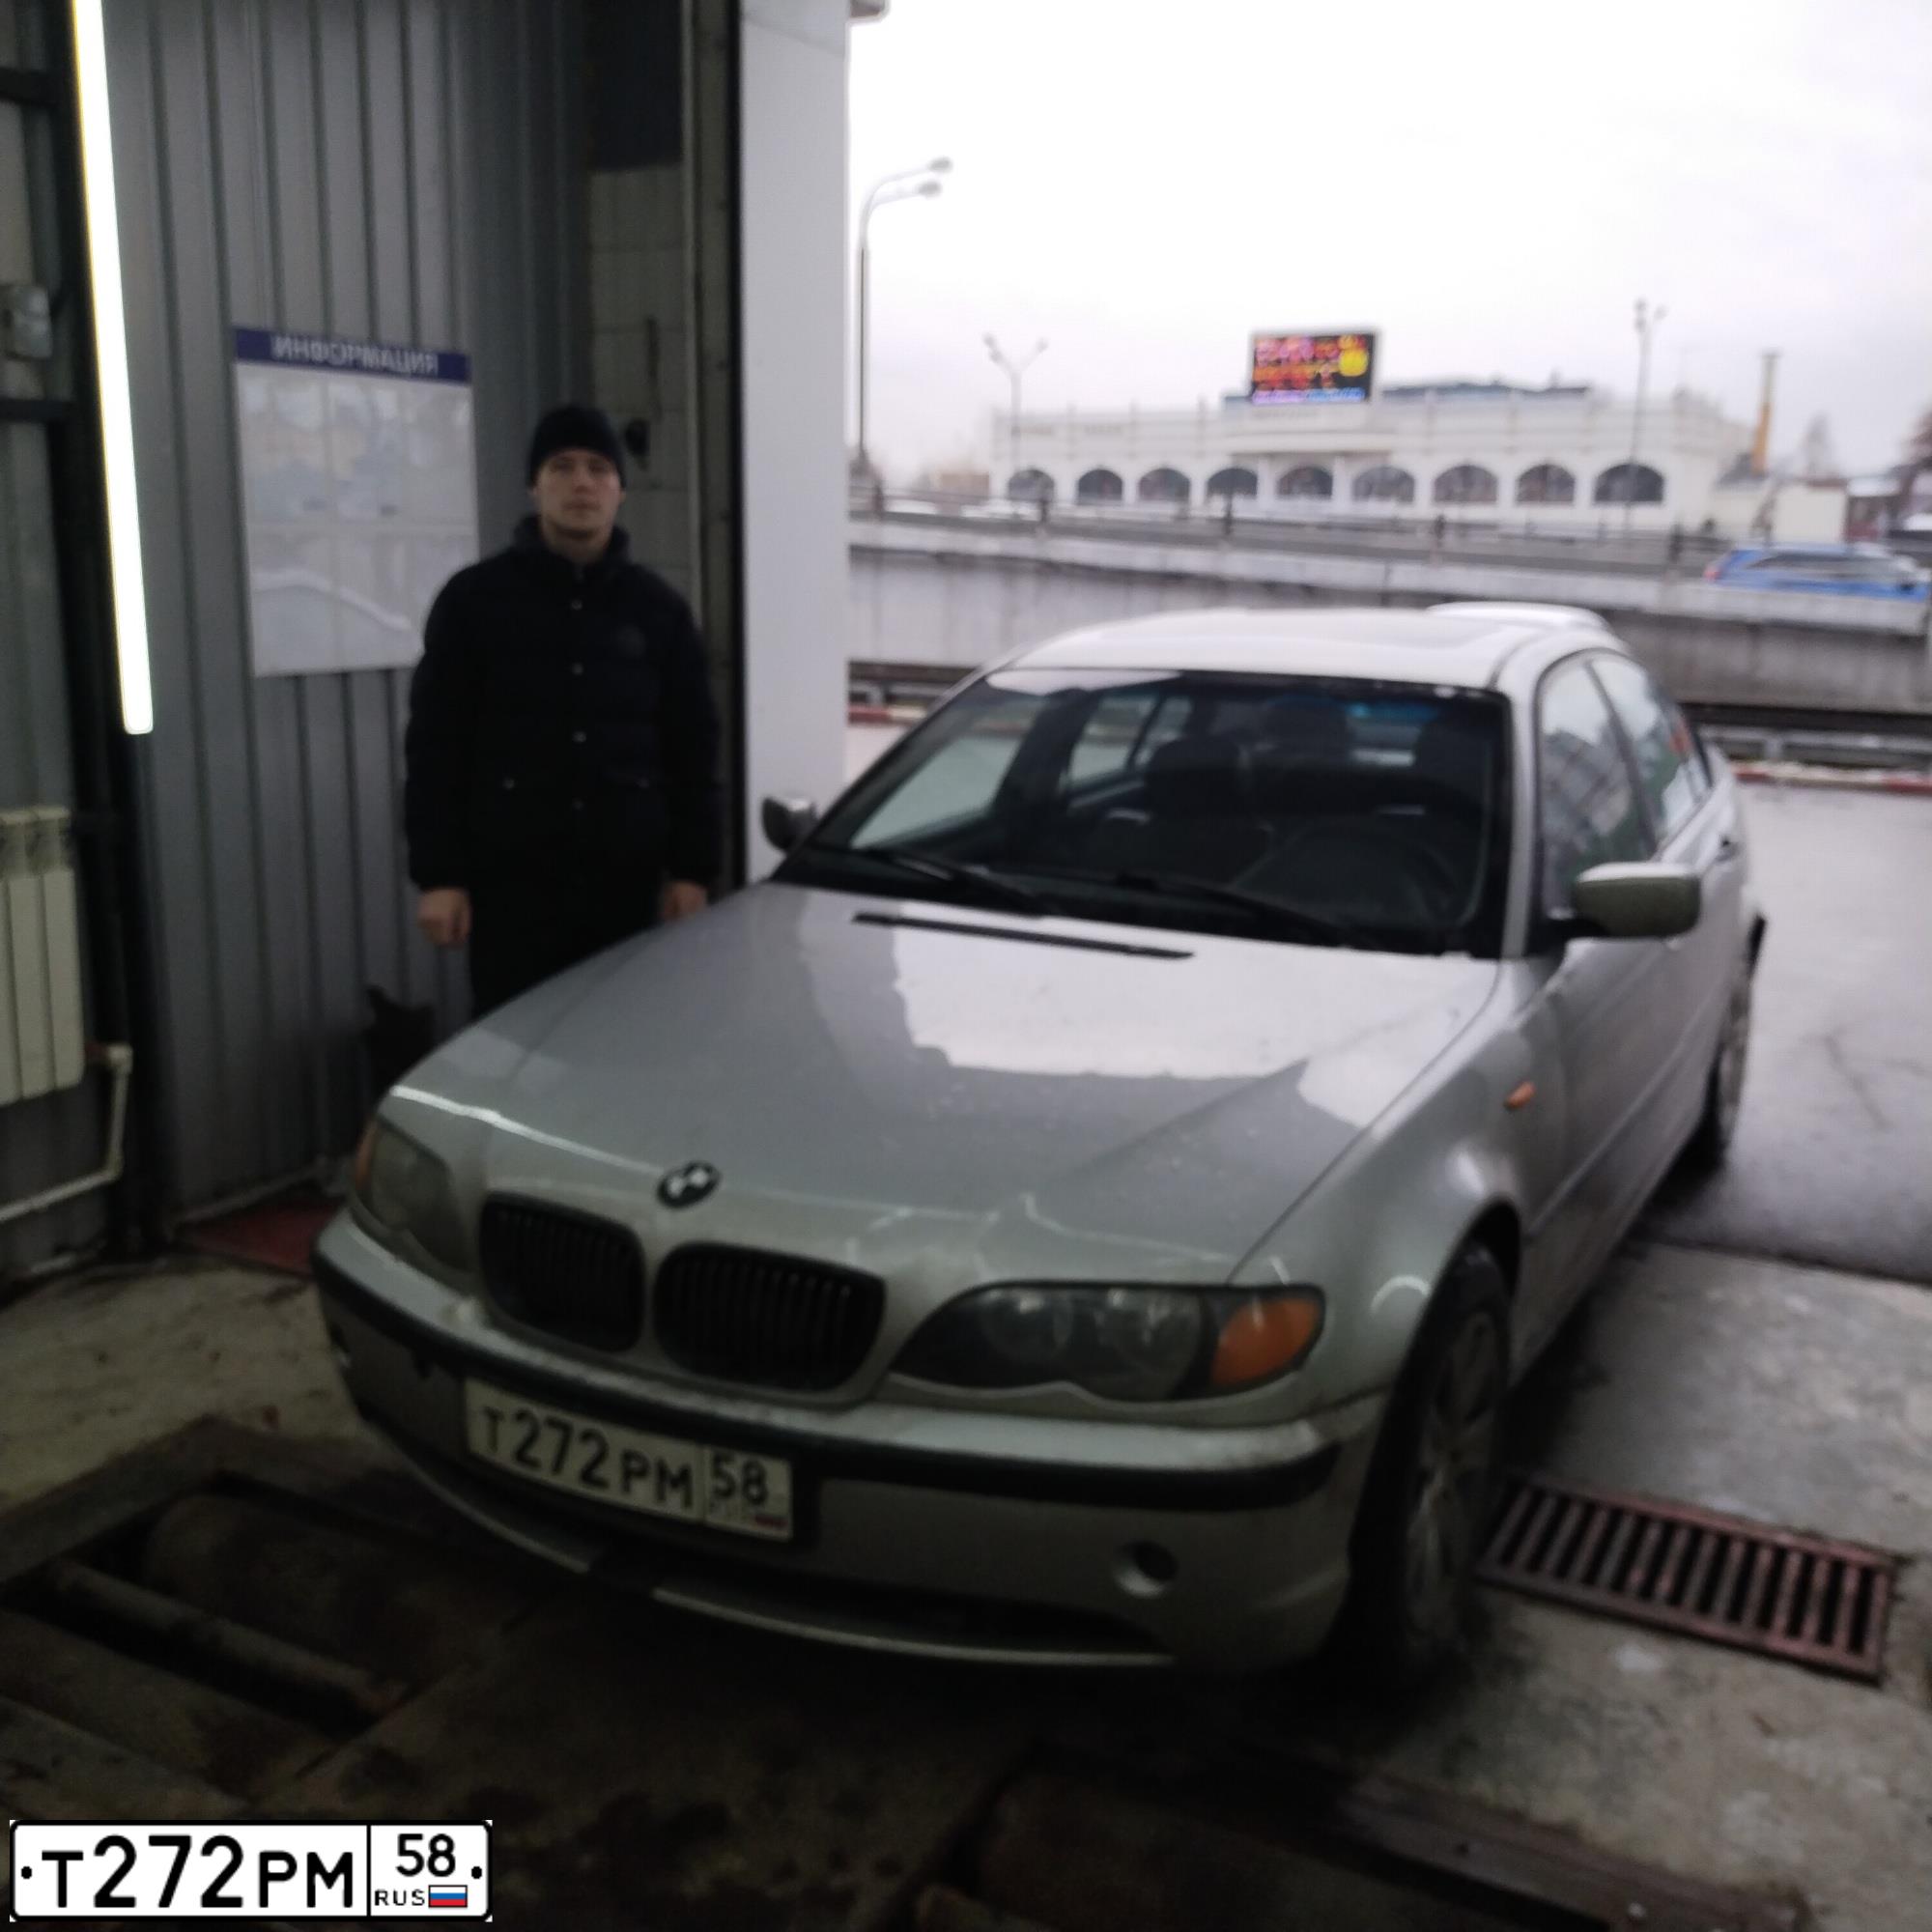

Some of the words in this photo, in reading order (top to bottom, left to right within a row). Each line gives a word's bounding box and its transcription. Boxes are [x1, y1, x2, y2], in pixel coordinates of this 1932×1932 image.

[271, 335, 438, 375] ИНФОРМАЦИЯ
[484, 1406, 694, 1509] Т272РМ
[712, 1453, 769, 1505] 58
